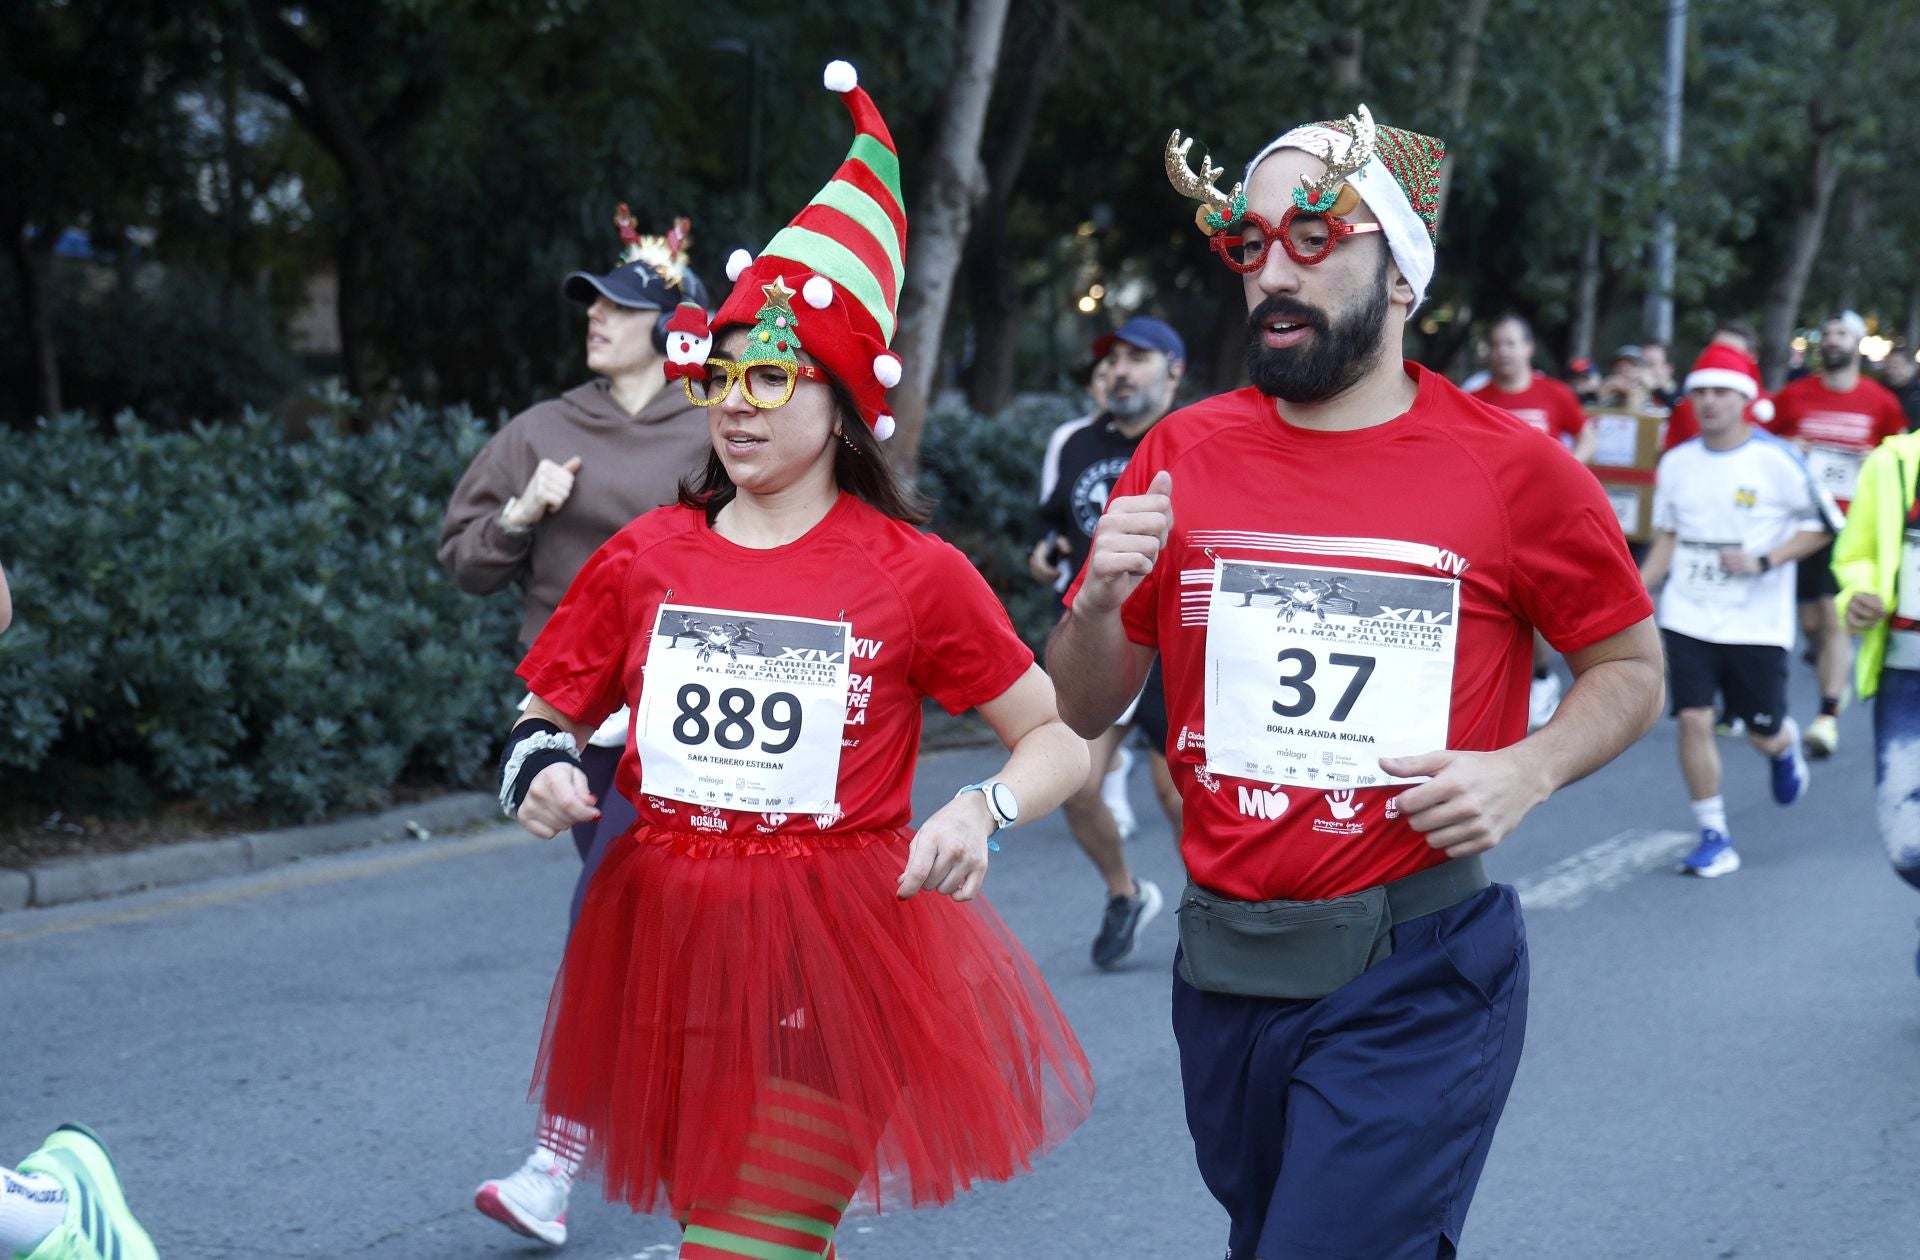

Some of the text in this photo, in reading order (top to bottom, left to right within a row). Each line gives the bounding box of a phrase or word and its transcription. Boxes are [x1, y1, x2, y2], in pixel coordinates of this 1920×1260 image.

[1372, 605, 1451, 624] XIV
[1313, 622, 1443, 640] SAN SILVESTRE
[1359, 619, 1443, 633] CARRERA
[1276, 626, 1442, 648] PALMA PALMILLA
[775, 646, 844, 663] XIV
[727, 662, 837, 677] SAN SILVESTRE
[764, 659, 837, 671] CARRERA
[696, 665, 837, 684] PALMA PALMILLA
[1271, 647, 1377, 722] 37
[672, 682, 803, 754] 889
[1266, 724, 1376, 744] BORJA ARANDA MOLINA
[687, 753, 784, 770] SARA TERRERO ESTEBAN
[1276, 748, 1307, 760] málaga
